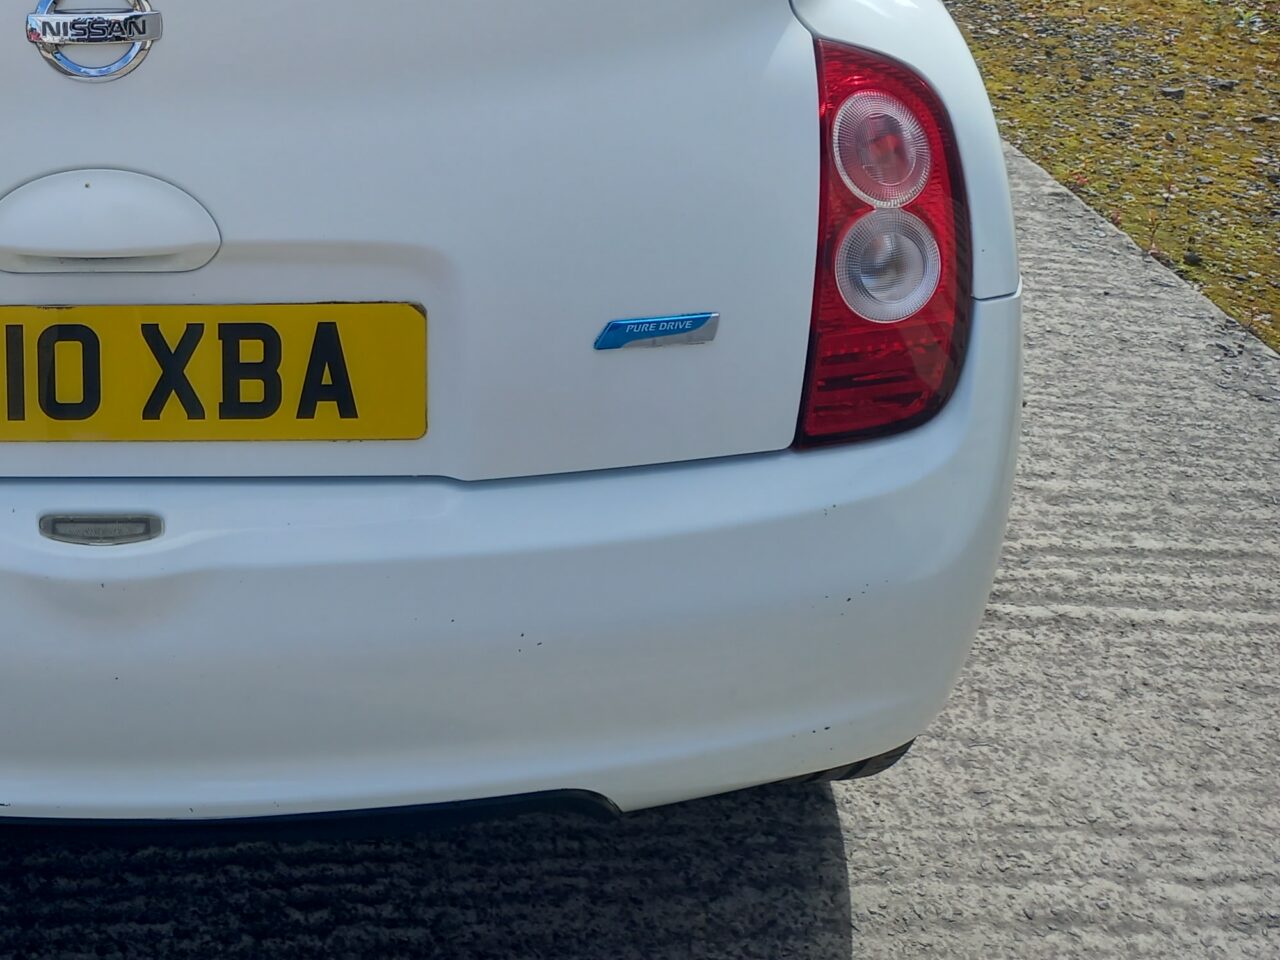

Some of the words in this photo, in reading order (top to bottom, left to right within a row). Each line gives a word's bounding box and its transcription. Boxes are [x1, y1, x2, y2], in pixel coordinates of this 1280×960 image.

[41, 20, 147, 38] NISSAN
[625, 323, 657, 333] PURE
[658, 320, 694, 331] DRIVE
[140, 321, 360, 421] XBA
